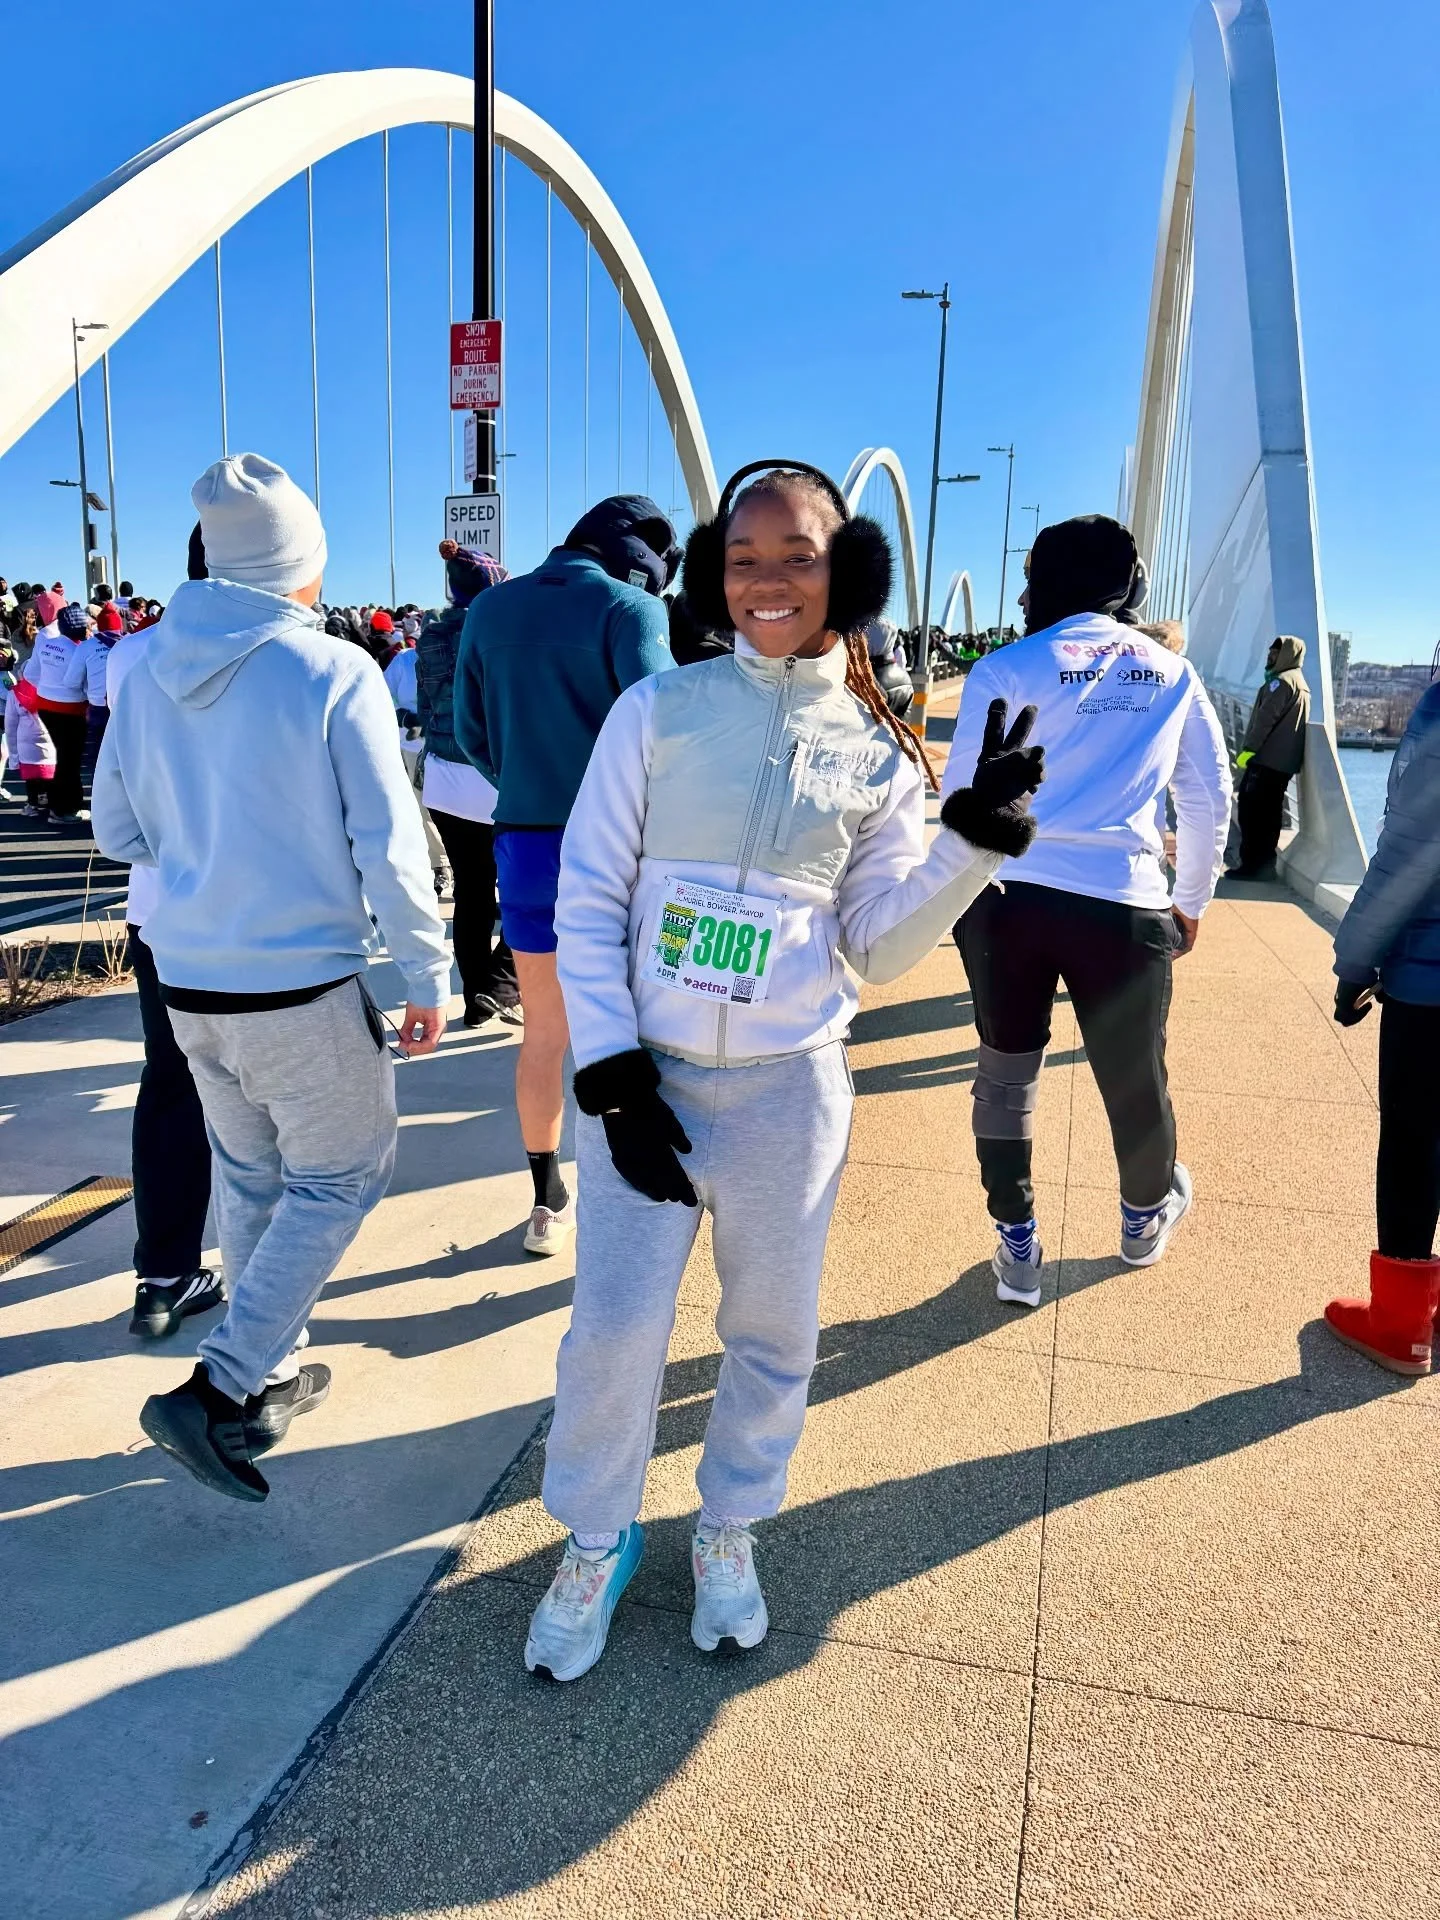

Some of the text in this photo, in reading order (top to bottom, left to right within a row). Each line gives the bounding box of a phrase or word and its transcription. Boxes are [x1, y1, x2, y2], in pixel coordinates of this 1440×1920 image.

[465, 323, 487, 337] SNOW
[460, 338, 492, 349] EMERGENCY
[464, 350, 487, 363] ROUTE
[453, 365, 498, 377] NO PARKING
[463, 378, 487, 390] DURING
[456, 391, 495, 403] EMERGENCY
[450, 505, 496, 523] SPEED
[454, 529, 490, 545] LIMIT
[1083, 641, 1150, 658] aetna
[1059, 668, 1166, 685] FITDC DPR
[664, 911, 694, 928] FITDC
[739, 909, 764, 919] MAYOR
[692, 915, 773, 977] 3081
[661, 968, 677, 981] DPR
[691, 979, 728, 995] aetna
